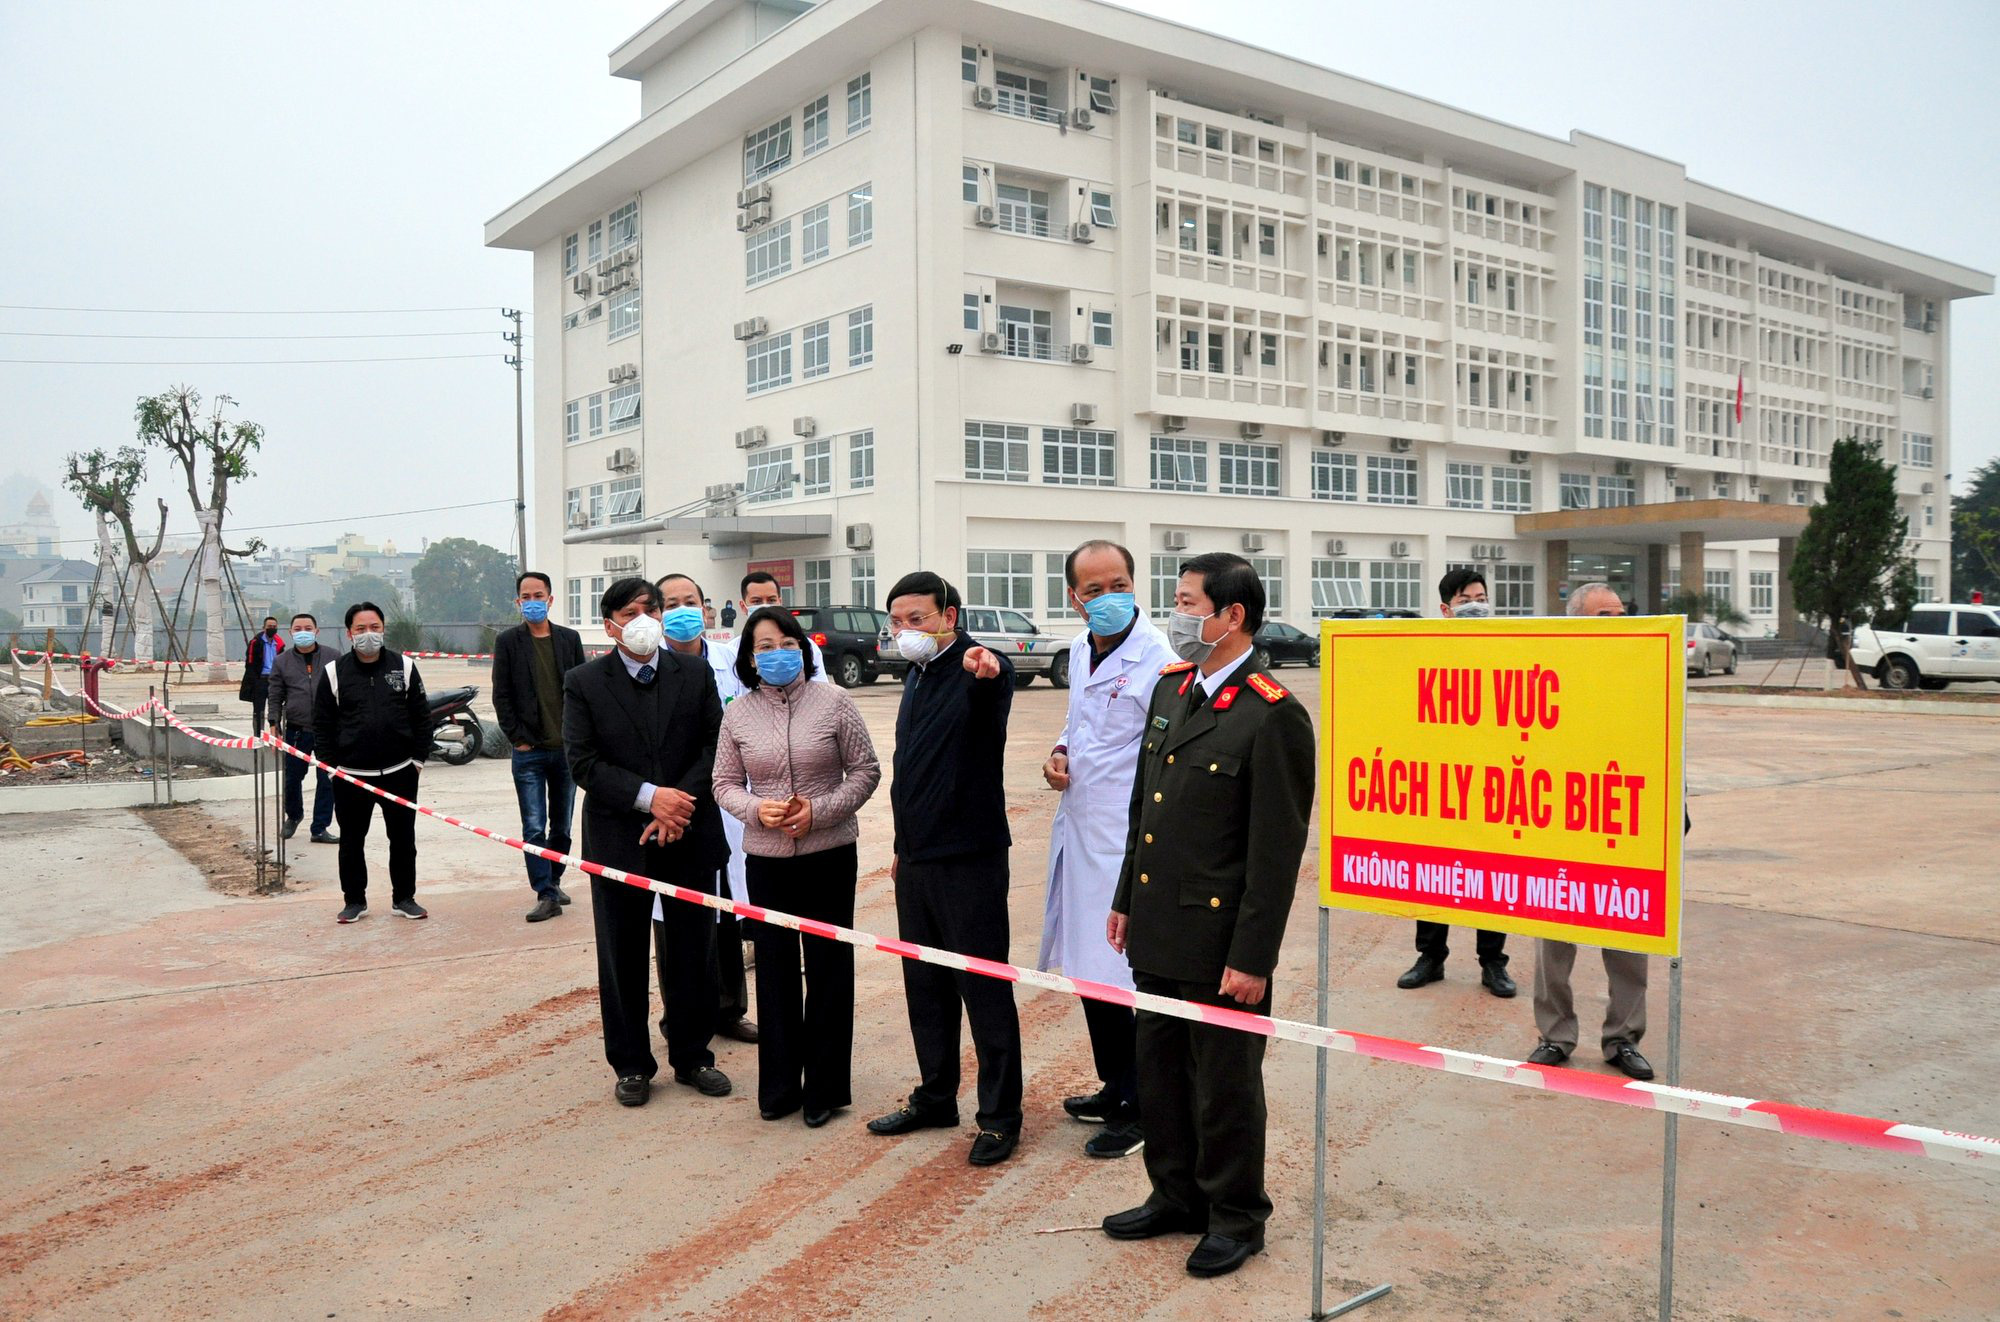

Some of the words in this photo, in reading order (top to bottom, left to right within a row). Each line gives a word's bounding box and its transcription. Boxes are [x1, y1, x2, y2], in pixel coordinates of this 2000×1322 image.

[1016, 641, 1035, 652] VTV
[1417, 667, 1482, 727] KHU
[1492, 663, 1560, 742] VỰC
[1348, 746, 1429, 817] CÁCH
[1439, 763, 1474, 821] LY
[1483, 754, 1553, 840] ĐẶC
[1564, 760, 1646, 849] BIỆT
[1342, 851, 1409, 890] KHÔNG
[1415, 860, 1484, 904] NHIỆM
[1490, 871, 1519, 911] VỤ
[1525, 867, 1586, 914] MIỄN
[1593, 878, 1649, 922] VÀO!
